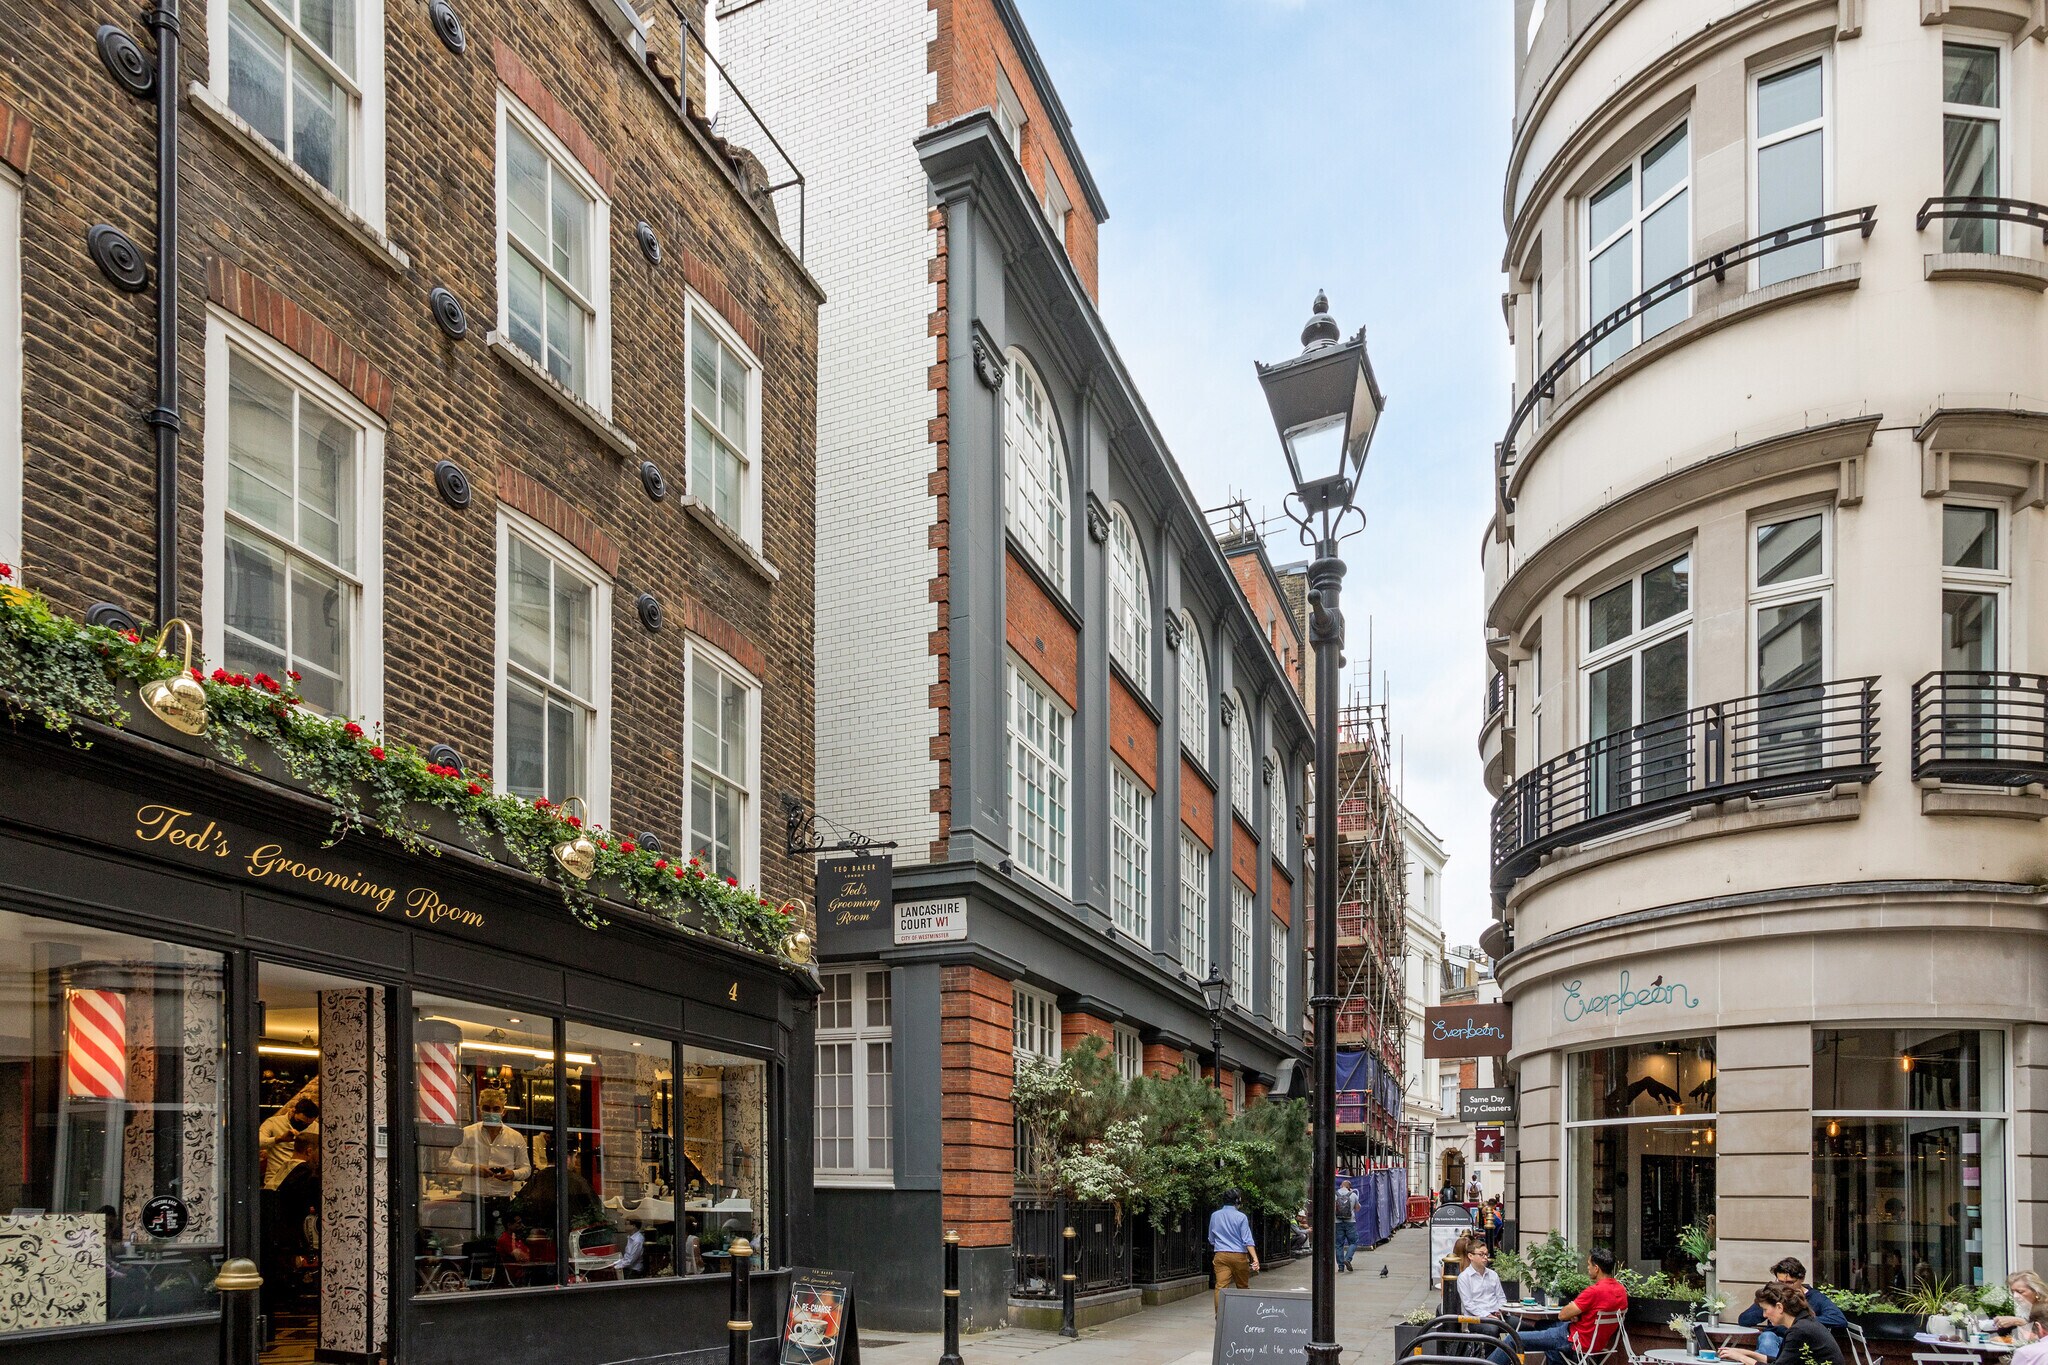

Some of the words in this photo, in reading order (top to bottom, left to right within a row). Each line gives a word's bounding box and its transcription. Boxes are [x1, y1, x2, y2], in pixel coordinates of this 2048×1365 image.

[135, 804, 231, 857] Ted's
[244, 844, 397, 912] Grooming
[405, 887, 485, 927] Room
[852, 864, 876, 872] BAKER
[840, 881, 867, 897] Ted's
[828, 897, 881, 912] Grooming
[900, 902, 960, 918] LANCASHIRE
[836, 911, 870, 926] Room
[901, 917, 932, 931] COURT
[935, 916, 949, 928] W1
[729, 982, 738, 1001] 4
[1562, 970, 1699, 1022] Everbean
[1431, 1018, 1505, 1041] Everbean
[1470, 1095, 1489, 1103] Same
[1490, 1095, 1505, 1104] Day
[1463, 1105, 1478, 1114] Dry
[1479, 1105, 1512, 1113] Cleaners
[801, 1303, 832, 1314] RE-CHARGE
[1226, 1341, 1255, 1361] Serving
[1259, 1344, 1268, 1354] all
[1273, 1345, 1284, 1354] the
